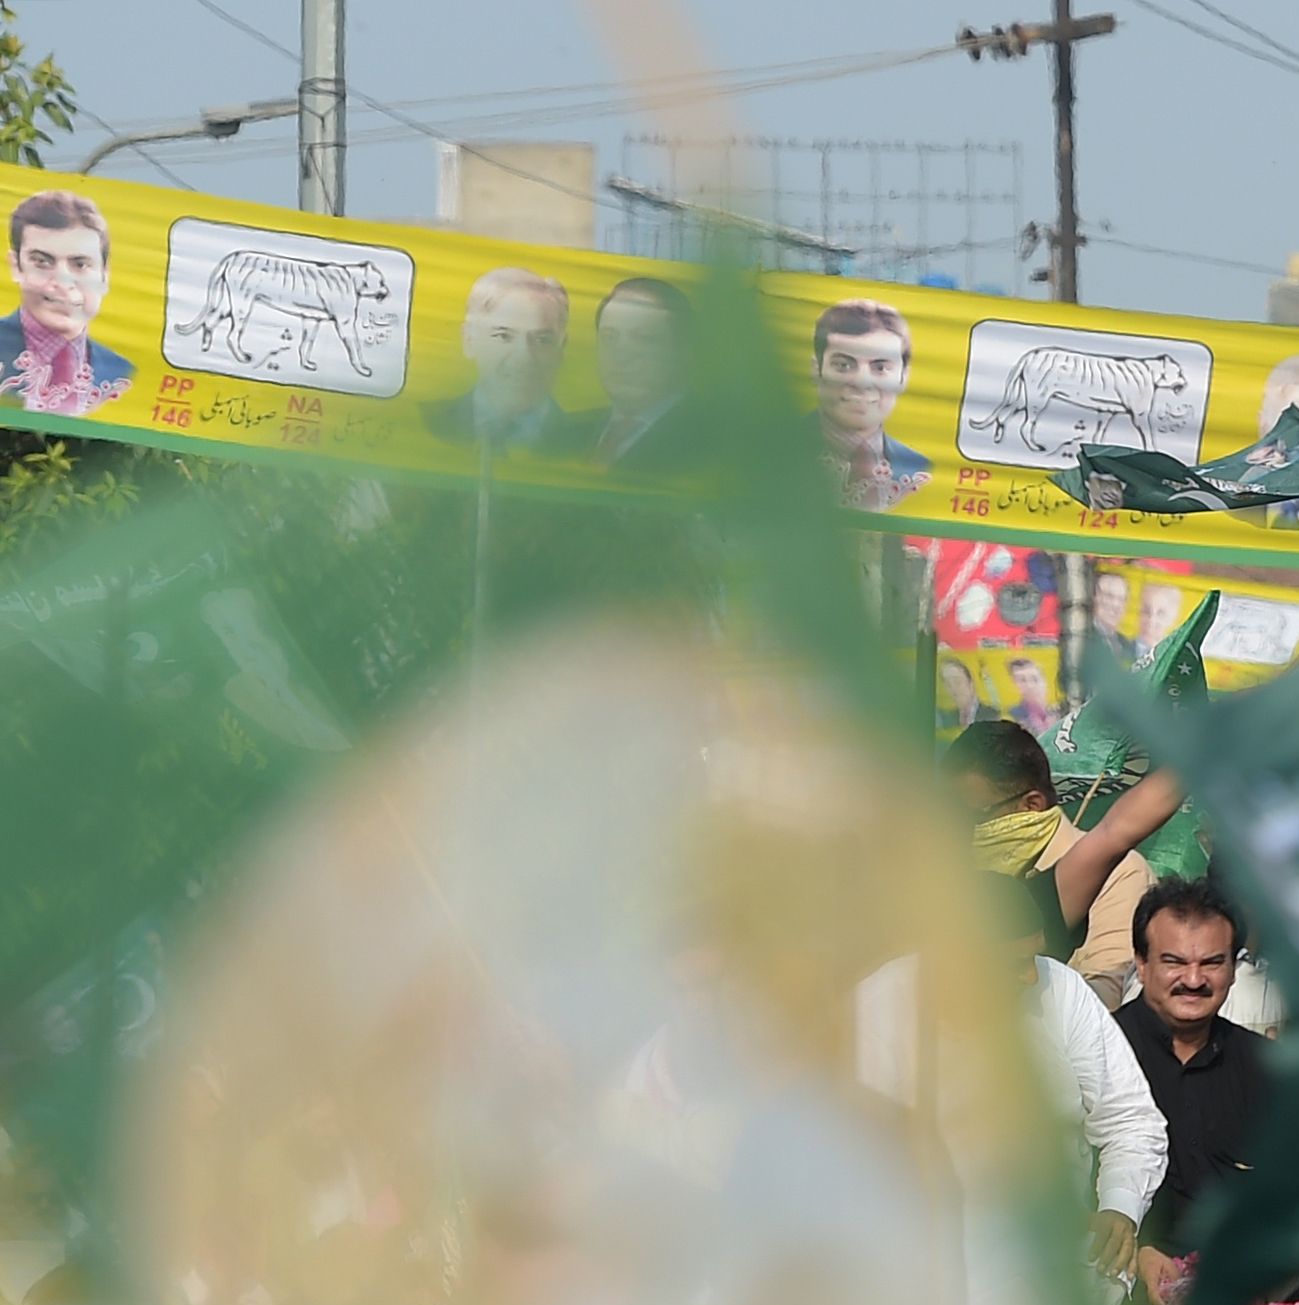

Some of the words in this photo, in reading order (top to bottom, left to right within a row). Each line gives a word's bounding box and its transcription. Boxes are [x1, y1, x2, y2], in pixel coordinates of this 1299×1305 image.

[159, 375, 194, 396] PP
[287, 395, 323, 416] NA
[151, 405, 193, 428] 146
[280, 423, 320, 444] 124
[958, 468, 992, 486] PP
[950, 496, 989, 517] 146
[1078, 510, 1118, 529] 124
